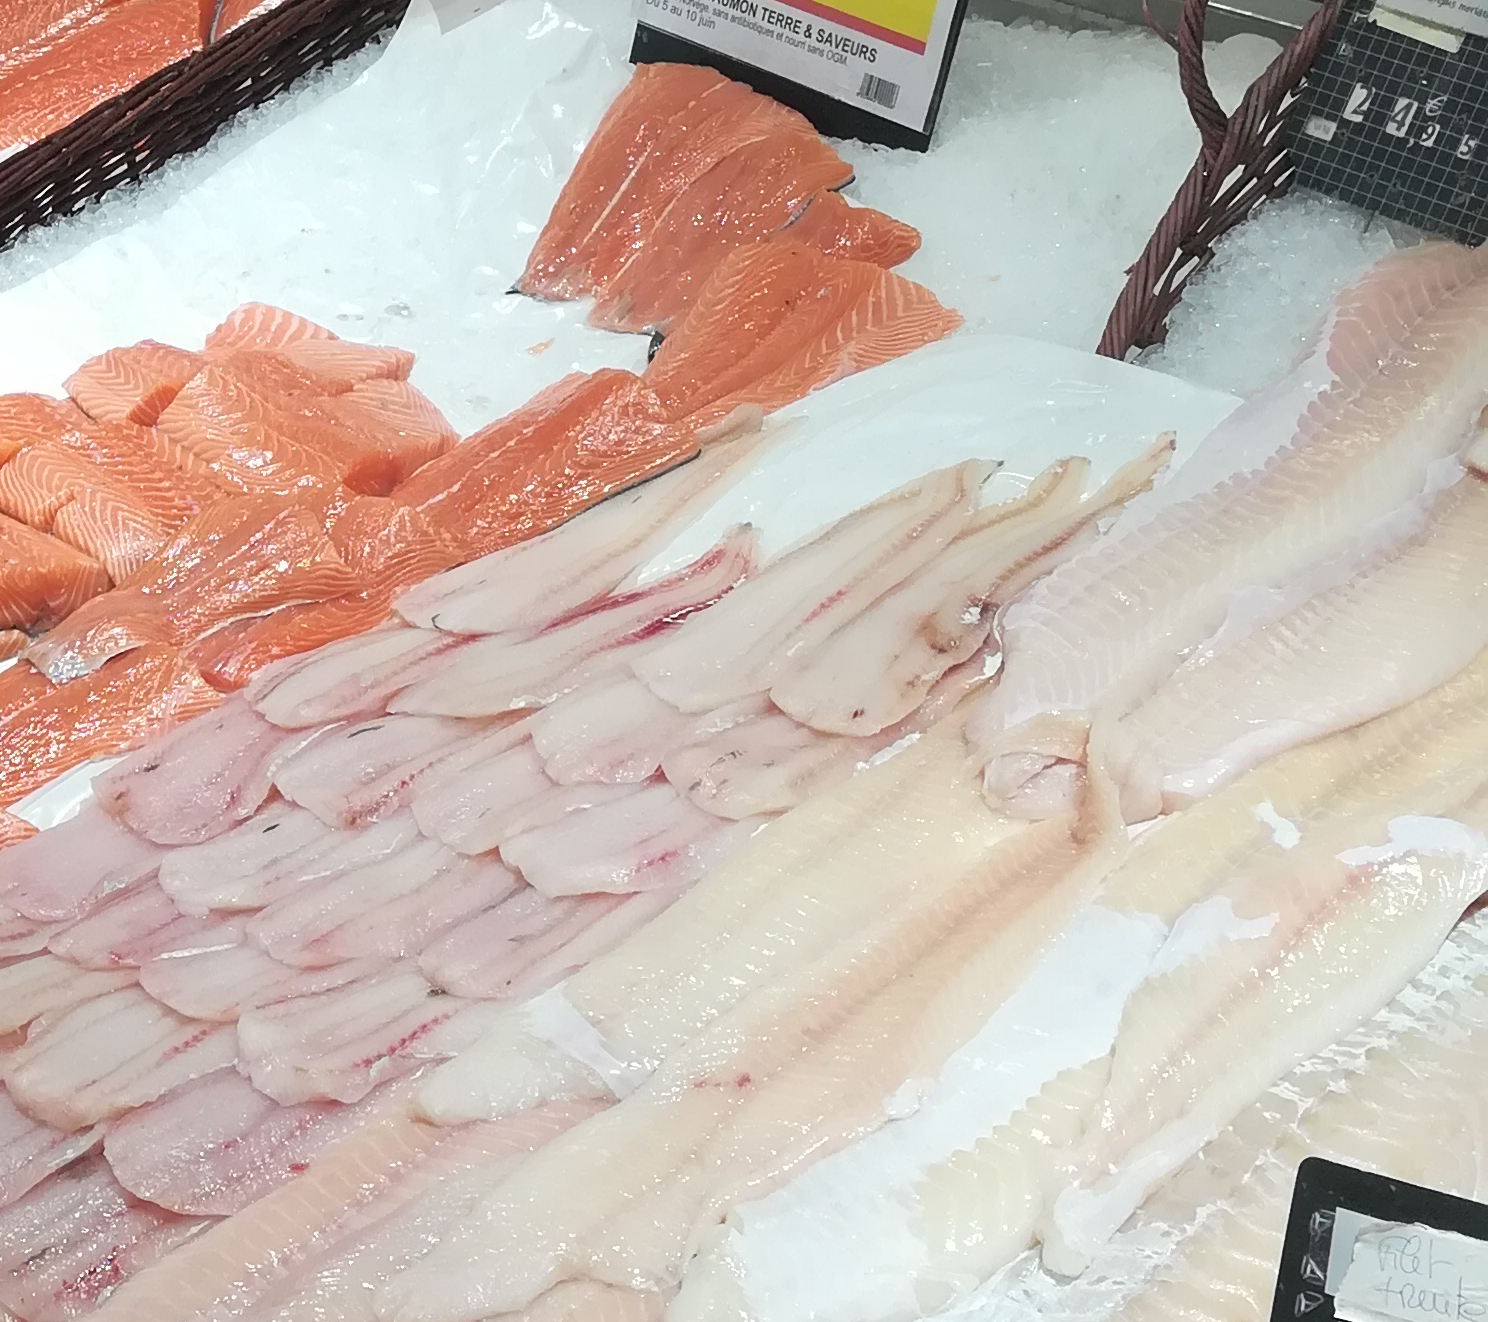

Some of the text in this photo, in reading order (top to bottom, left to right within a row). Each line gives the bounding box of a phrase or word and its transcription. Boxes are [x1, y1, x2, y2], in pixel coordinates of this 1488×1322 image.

[661, 0, 669, 11] 5
[670, 4, 684, 18] au
[685, 6, 698, 22] 10
[697, 12, 716, 30] juin
[712, 7, 730, 22] sans
[729, 12, 775, 39] antibiotiques
[776, 29, 784, 41] et
[807, 42, 825, 59] sans
[761, 6, 803, 35] TERRE
[803, 23, 814, 39] &
[815, 28, 879, 63] SAVEURS
[1378, 1234, 1454, 1279] Filet
